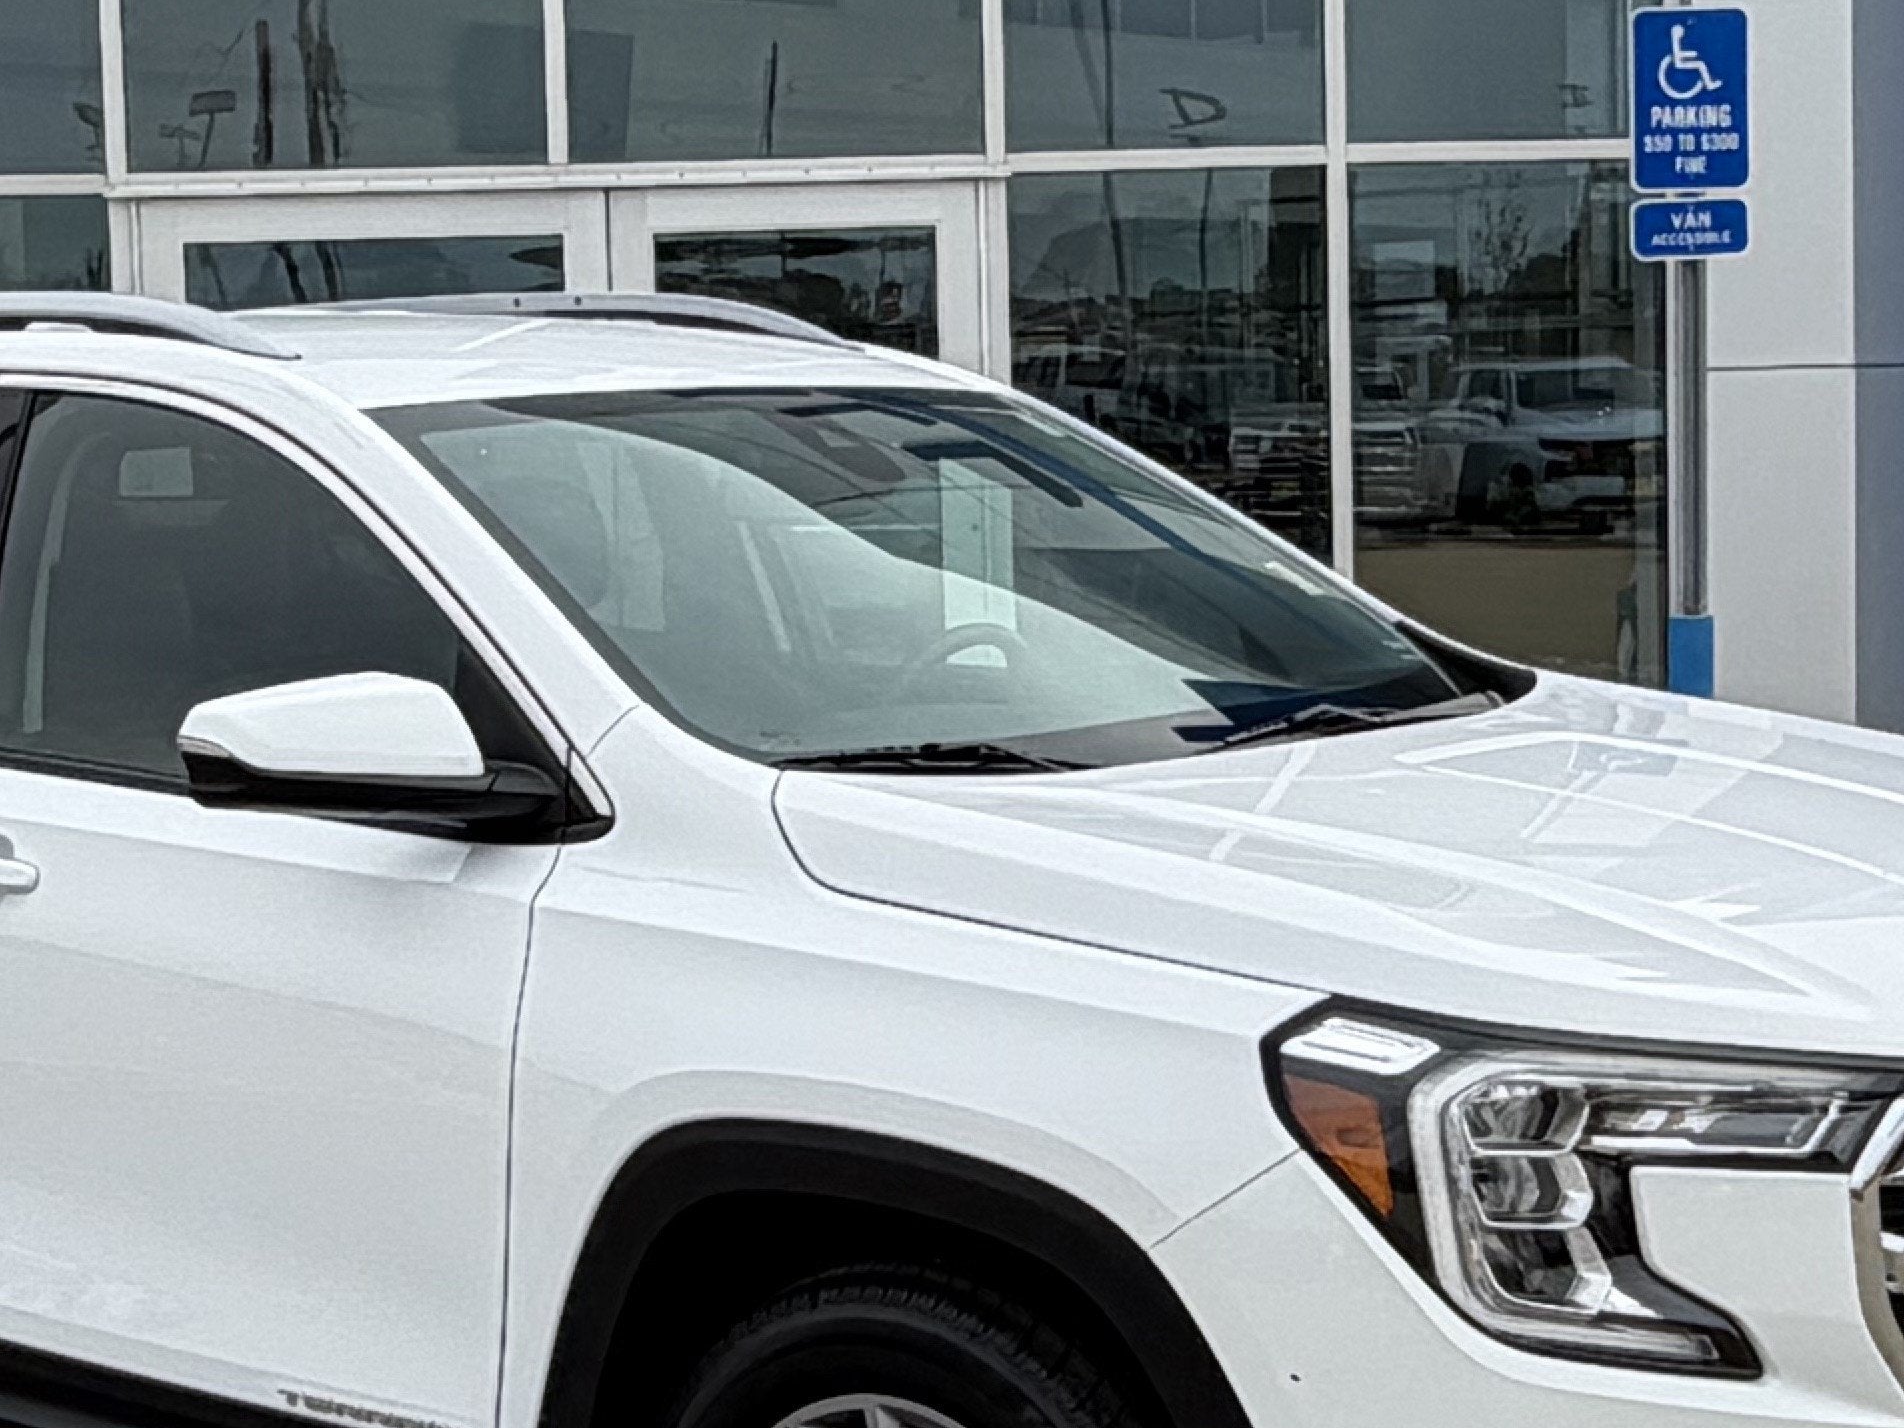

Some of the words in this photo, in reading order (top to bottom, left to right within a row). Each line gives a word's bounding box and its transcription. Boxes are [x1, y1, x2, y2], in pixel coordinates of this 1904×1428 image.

[1650, 104, 1733, 129] PARKING
[1677, 133, 1696, 152] TO
[1674, 155, 1708, 174] FINE
[1669, 210, 1712, 230] VAN
